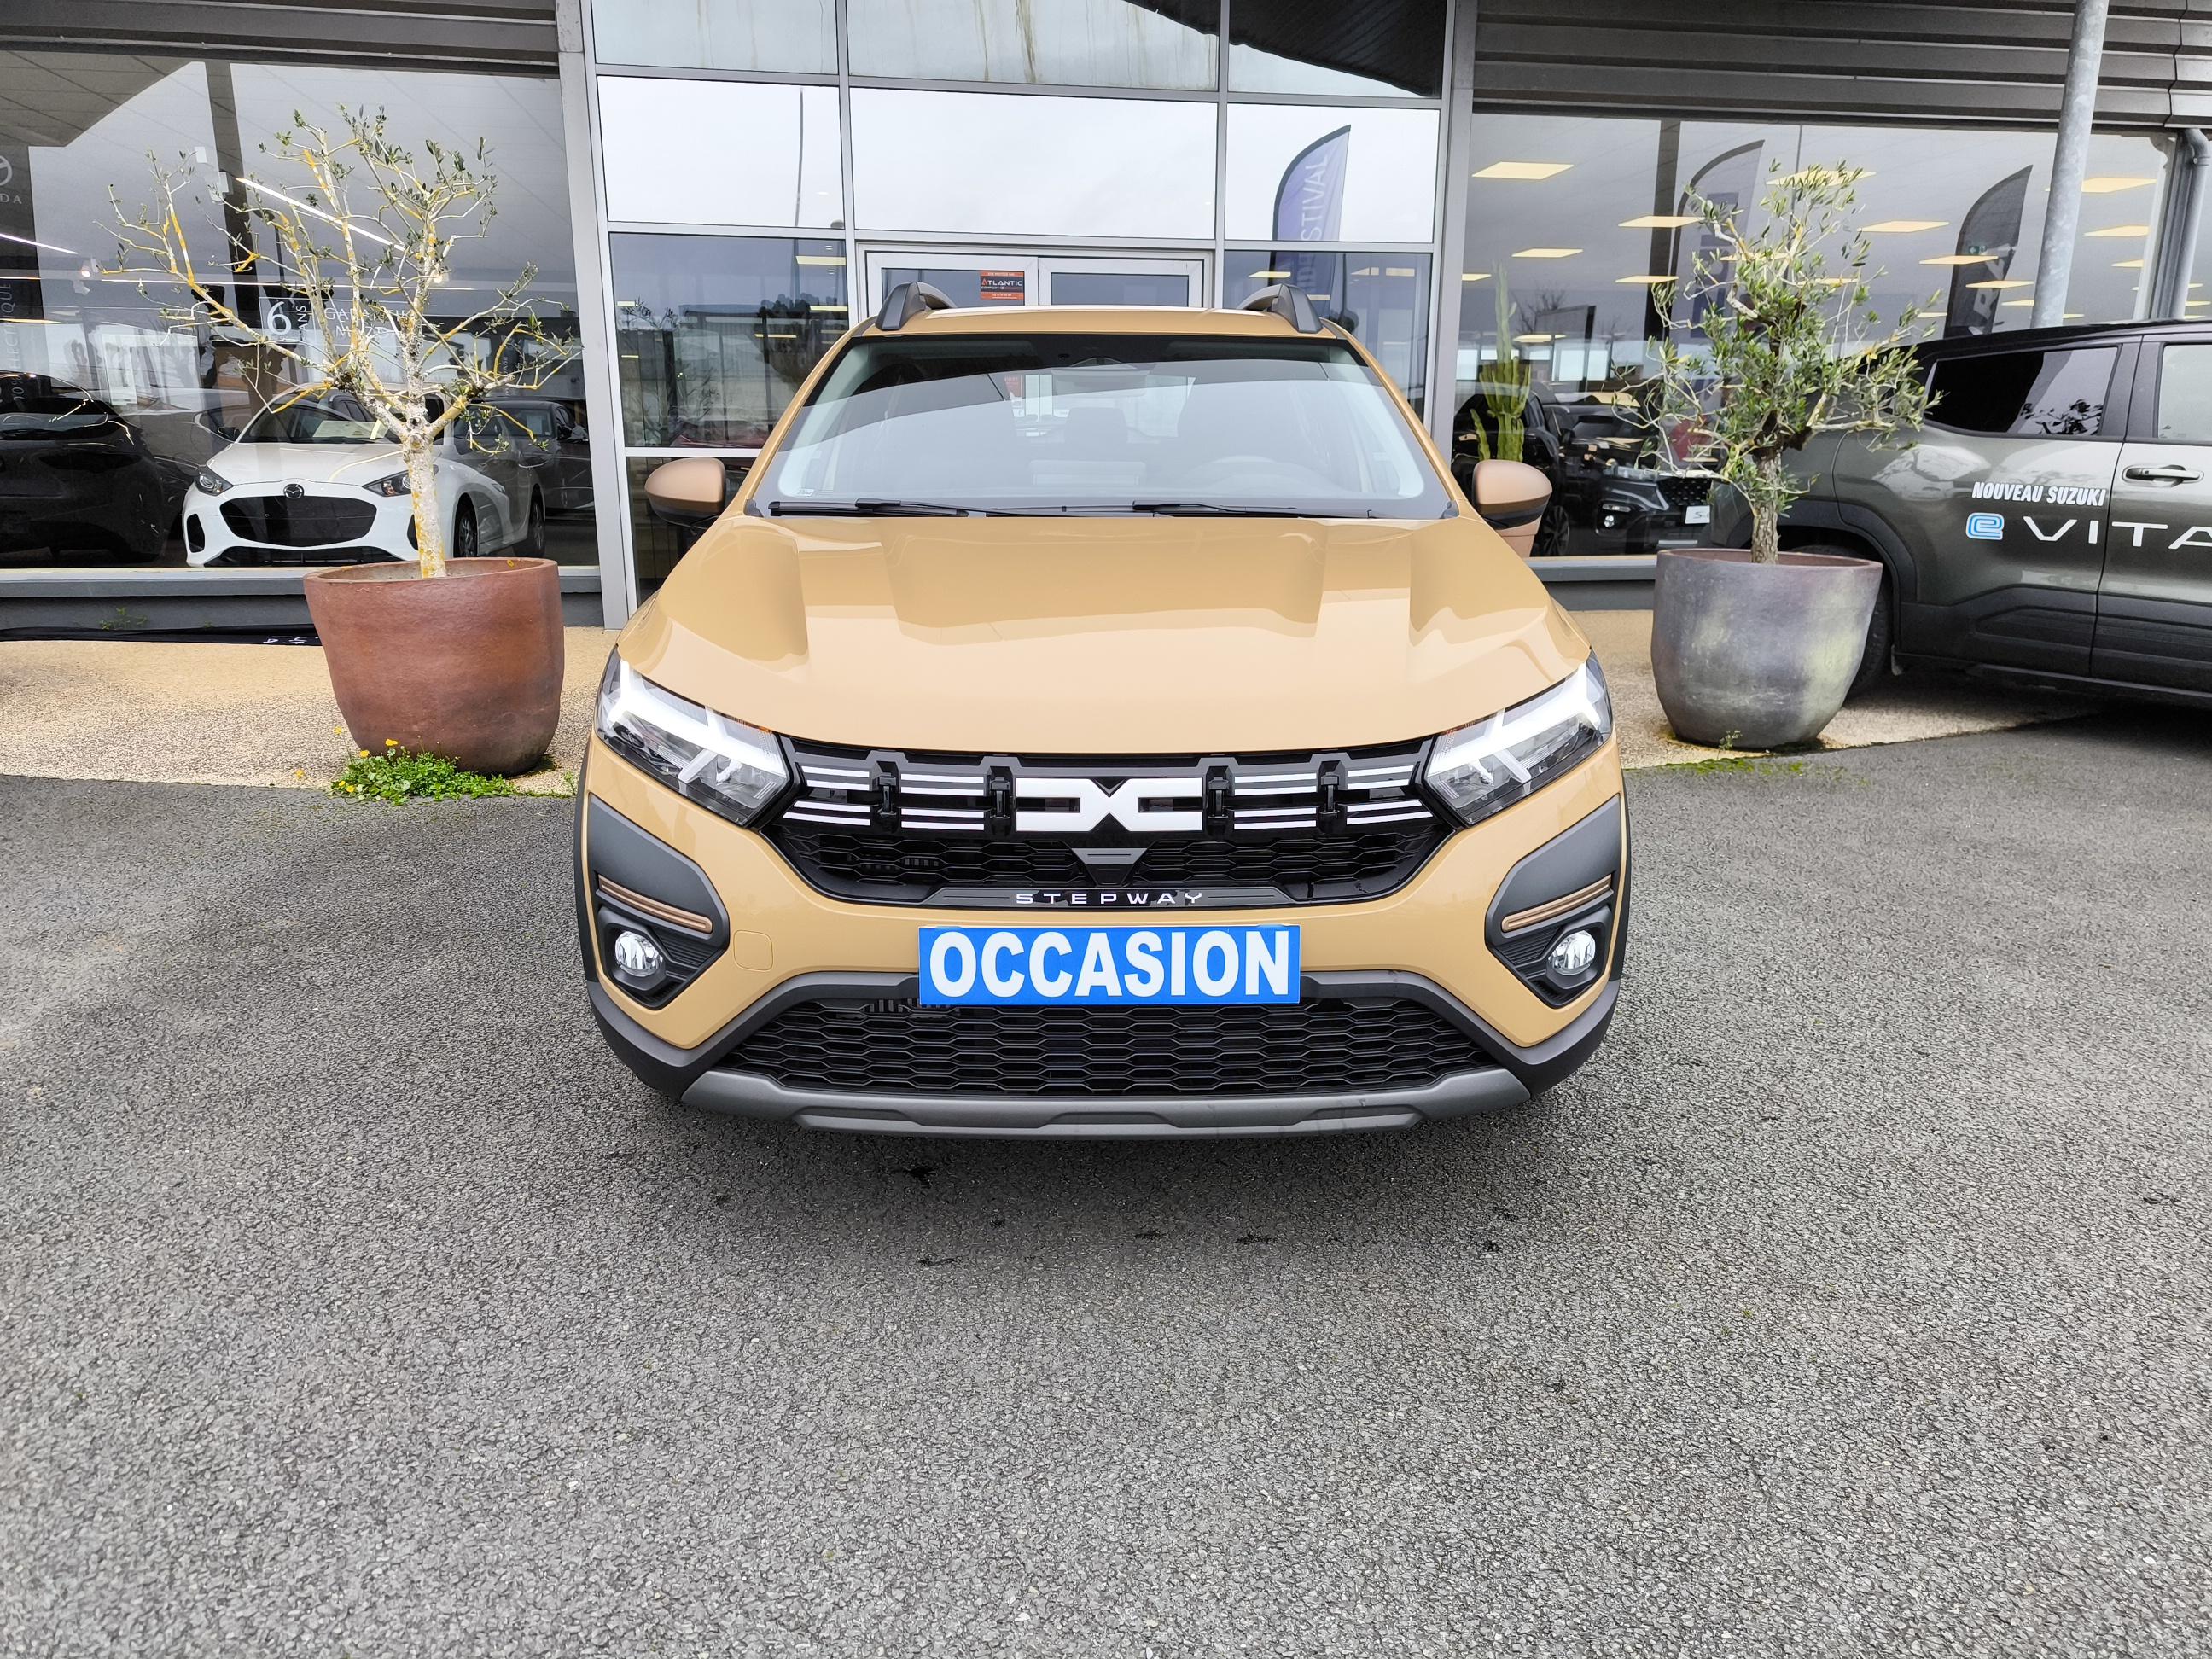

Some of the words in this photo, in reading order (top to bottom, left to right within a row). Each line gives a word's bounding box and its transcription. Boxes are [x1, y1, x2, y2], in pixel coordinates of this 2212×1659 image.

[982, 278, 1023, 287] ATLANTIC
[267, 300, 292, 335] 6
[295, 306, 308, 331] ANS
[1972, 481, 2044, 503] NOUVEAU
[2046, 486, 2106, 507] SUZUKI
[2023, 515, 2212, 550] VITA
[1016, 893, 1202, 905] STEPWAY
[929, 931, 1289, 998] OCCASION
